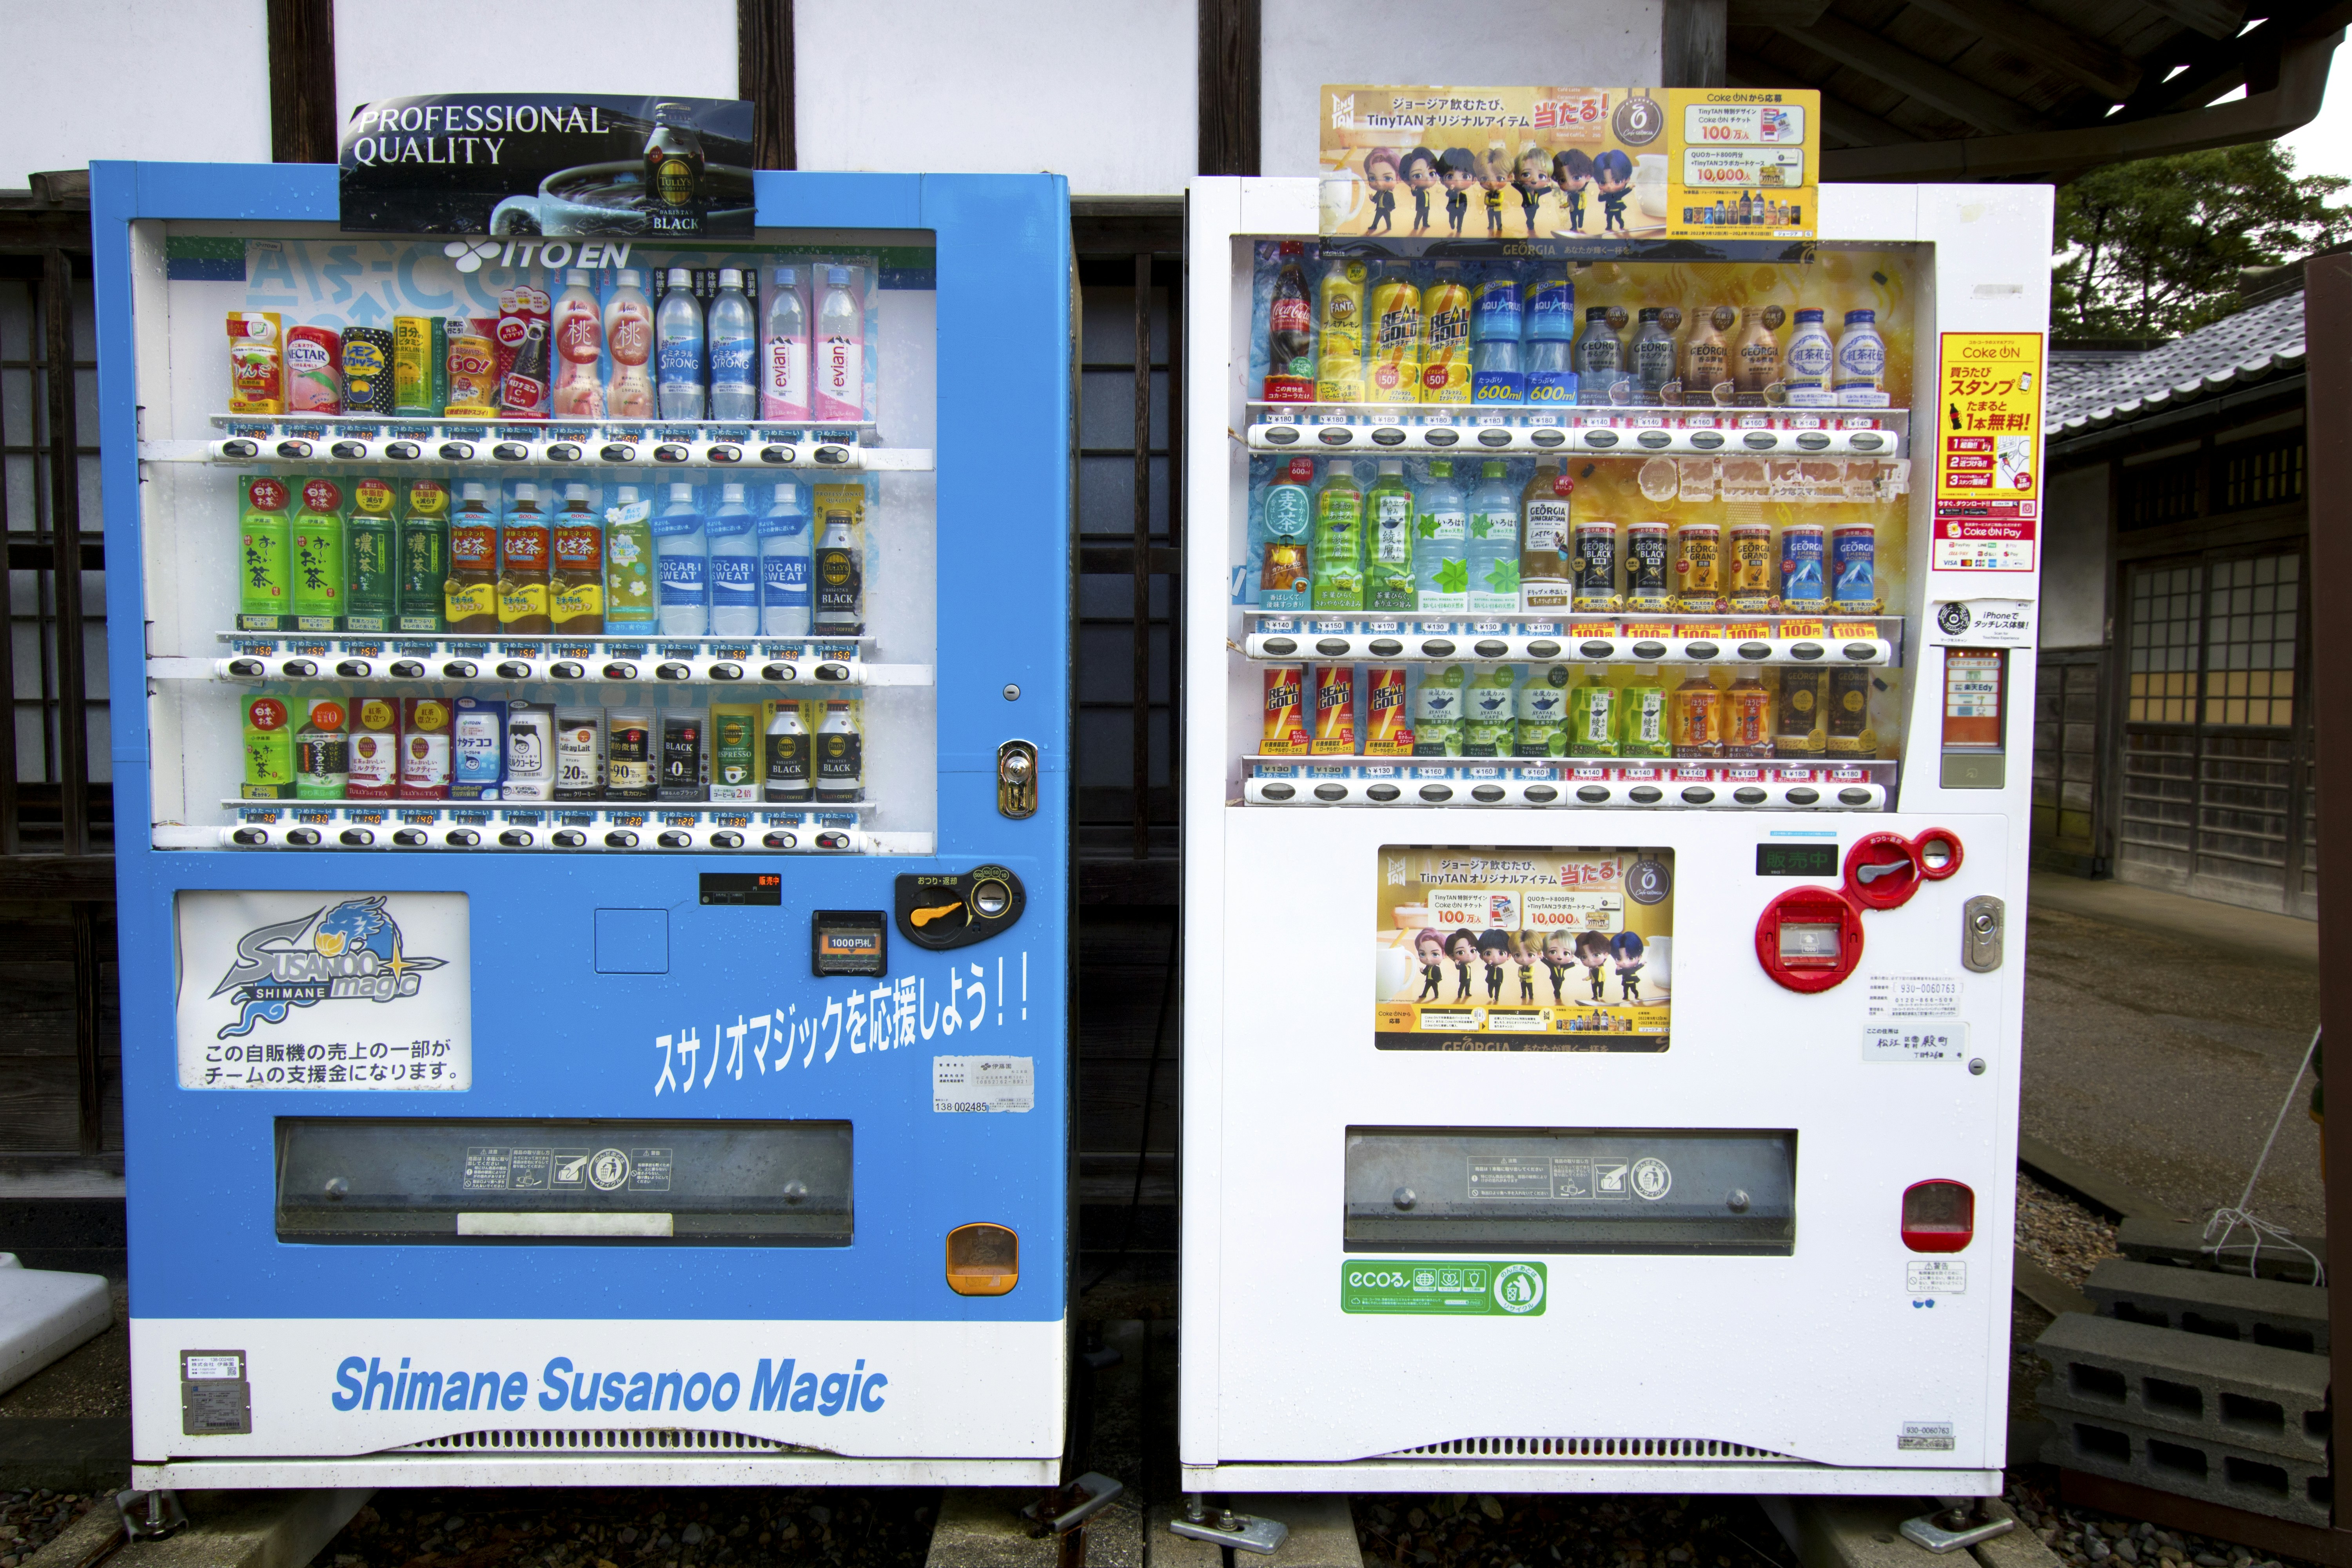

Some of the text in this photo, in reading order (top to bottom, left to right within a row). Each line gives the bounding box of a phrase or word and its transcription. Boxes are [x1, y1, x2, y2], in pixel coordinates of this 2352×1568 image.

[1393, 98, 1505, 111] ジョージア飲むたび、
[1534, 93, 1610, 130] 当たる!
[358, 105, 609, 134] PROFESSIONAL
[354, 137, 505, 167] QUALITY
[660, 176, 691, 188] TULLY'S
[654, 218, 699, 230] BLACK
[1503, 240, 1555, 255] GEORGIA
[501, 241, 632, 269] ITO EN
[1330, 301, 1356, 312] FANTA
[1481, 298, 1522, 312] AQUARIUS
[1323, 320, 1360, 330] プレミアレモン
[568, 319, 592, 347] 桃
[619, 319, 641, 347] 桃
[1380, 326, 1418, 343] GOLD
[288, 348, 326, 362] NECTAR
[346, 346, 376, 357] レモン
[1794, 348, 1831, 361] 紅茶花伝
[1963, 347, 1997, 358] Coke
[446, 356, 492, 374] GO!
[661, 358, 699, 371] STRONG
[712, 358, 750, 370] STRONG
[773, 345, 787, 388] evian
[833, 345, 846, 388] evian
[1950, 367, 1991, 378] 買うたび
[1477, 384, 1522, 402] 600ml
[1530, 383, 1576, 401] 600ml
[1949, 379, 2015, 396] スタンプ
[1967, 401, 2007, 411] たまると
[1273, 415, 1292, 423] ¥180
[1966, 414, 2031, 431] 1本無料!
[361, 489, 384, 498] 体脂肪
[416, 490, 437, 498] 体脂肪
[1530, 504, 1566, 516] GEORGIA
[2004, 528, 2022, 538] Pay
[452, 537, 486, 555] むぎ茶
[505, 537, 539, 555] むぎ茶
[556, 537, 594, 555] むぎ茶
[659, 562, 702, 572] POCARI
[712, 563, 754, 572] POCARI
[764, 563, 807, 573] POCARI
[824, 564, 849, 572] TULLY'S
[659, 572, 695, 582] SWEAT
[712, 572, 748, 581] SWEAT
[764, 572, 802, 581] SWEAT
[822, 594, 853, 604] BLACK
[1321, 592, 1356, 600] 茶葉ひらく、
[455, 603, 484, 612] ゴクゴク
[1267, 601, 1304, 609] 後味すっきり
[1783, 624, 1820, 637] 100円
[1974, 621, 2029, 630] タッチレス体験!
[1268, 695, 1299, 711] GOLD
[364, 714, 387, 723] 際立つ
[417, 715, 439, 724] 際立つ
[457, 737, 492, 747] ナタデココ
[666, 742, 693, 752] BLACK
[563, 765, 580, 780] 20
[613, 765, 629, 779] 90
[772, 764, 801, 773] BLACK
[823, 763, 851, 772] BLACK
[1441, 860, 1536, 871] ジョージア飲むたび、
[1767, 851, 1828, 869] 販売中
[1560, 857, 1623, 886] 当たる!
[759, 876, 779, 886] 販売中
[918, 877, 957, 886] おつり・返却
[832, 938, 871, 948] 1000円札
[256, 987, 325, 998] SHIMANE
[332, 975, 420, 1001] magic
[1901, 984, 1955, 993] 930-0060763
[205, 1038, 452, 1063] この自販機の売上の一部が
[205, 1062, 456, 1084] チームの支援金になります。
[330, 1356, 889, 1417] Shimane Susanoo Magic
